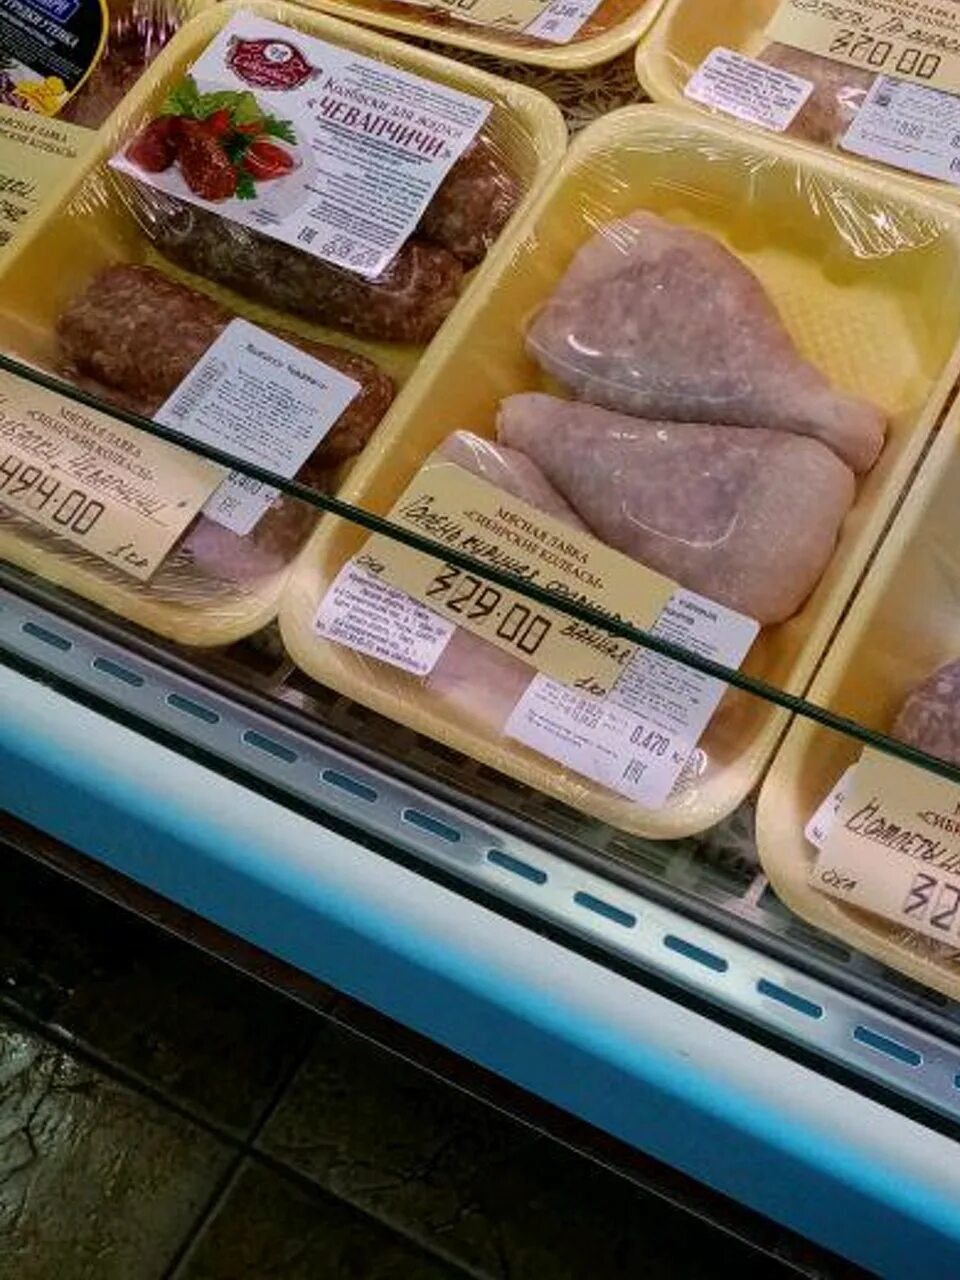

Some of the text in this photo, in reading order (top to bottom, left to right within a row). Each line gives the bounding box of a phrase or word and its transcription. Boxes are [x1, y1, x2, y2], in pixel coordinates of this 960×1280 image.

[0, 454, 105, 535] 494.00
[496, 506, 590, 565] МЯСНАЯ ЛАВКА
[425, 563, 552, 656] 329.00
[629, 723, 671, 757] 0.470
